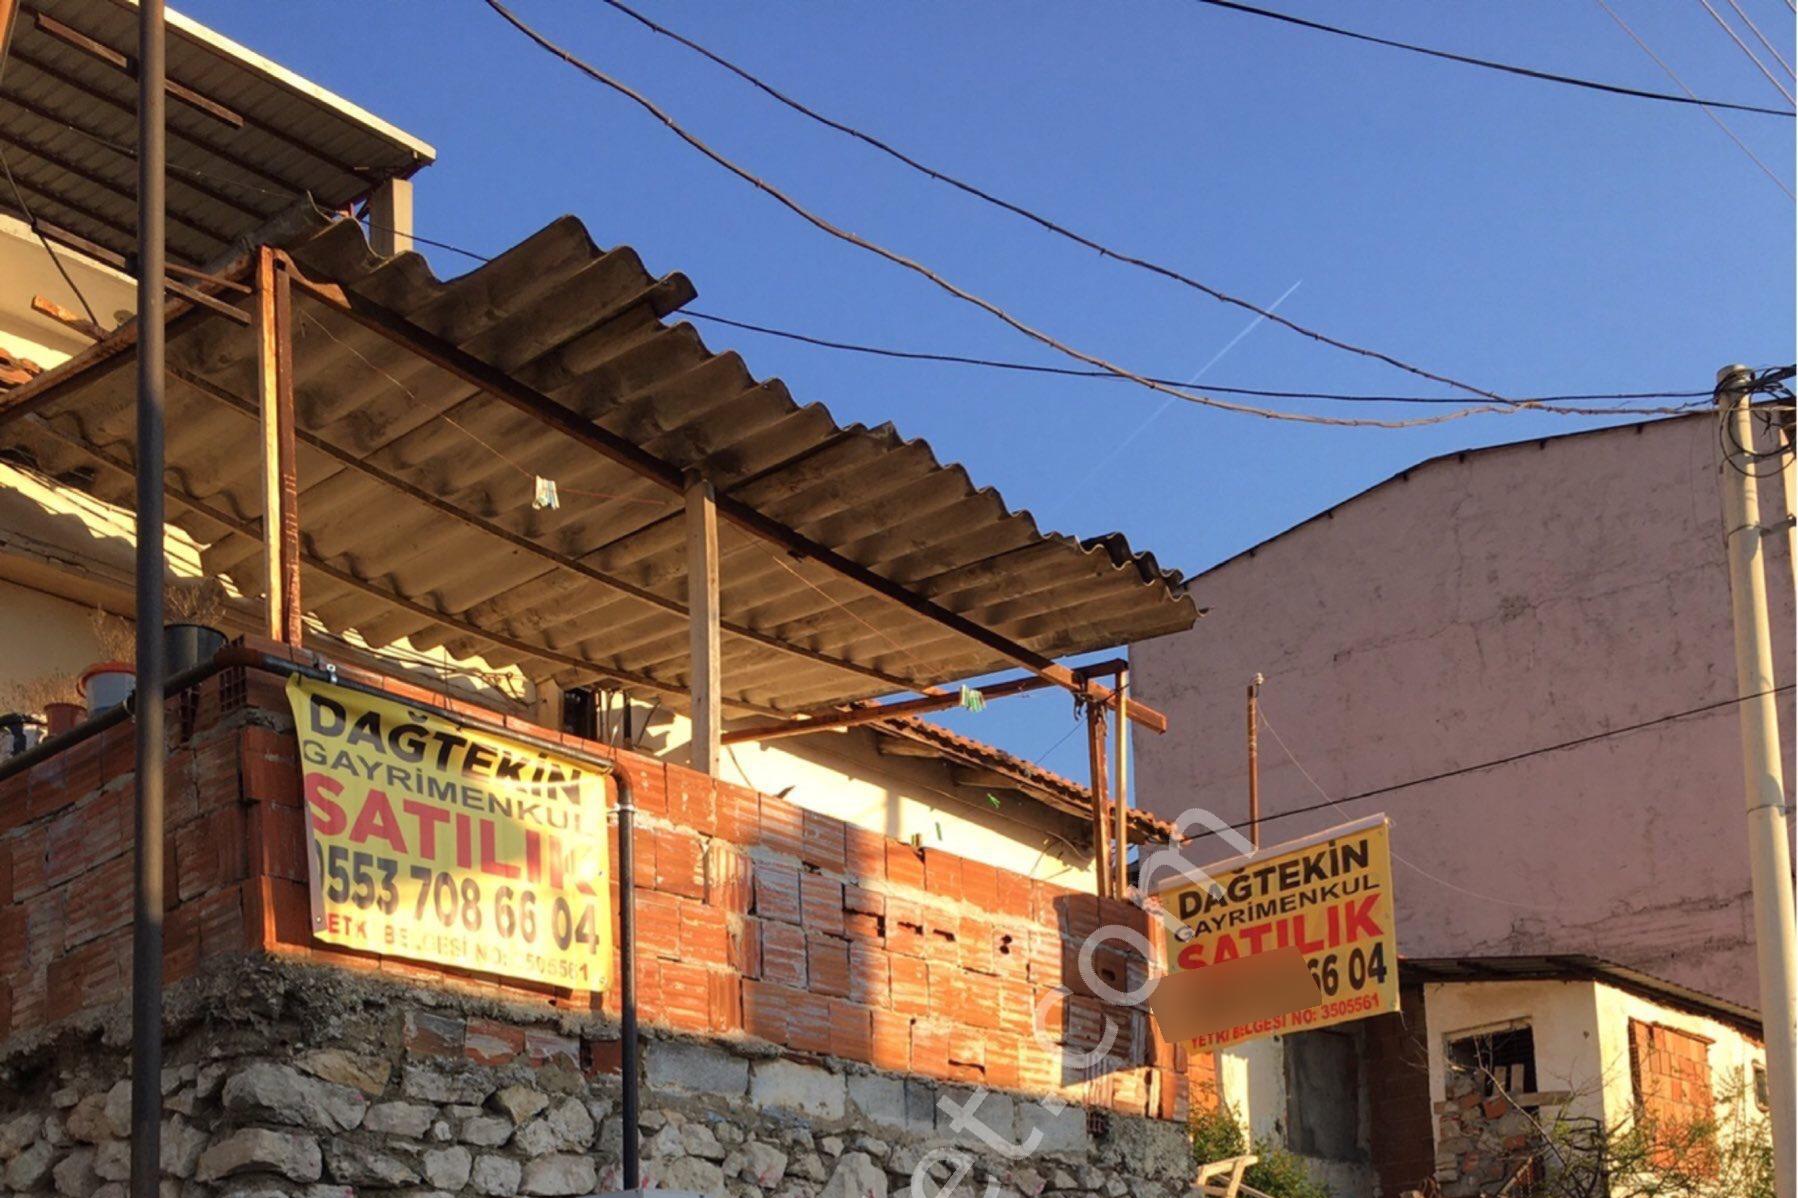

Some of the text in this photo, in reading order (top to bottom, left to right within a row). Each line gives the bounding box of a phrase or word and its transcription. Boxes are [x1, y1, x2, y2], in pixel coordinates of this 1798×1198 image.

[303, 739, 593, 837] GAYRİMENKUL
[310, 692, 582, 806] DAĞTEKİN
[304, 771, 598, 897] SATILIK
[410, 864, 482, 932] 708
[494, 885, 537, 944] 66
[552, 896, 600, 955] 04
[1174, 873, 1381, 943] GAYRİMENKUL
[1178, 838, 1369, 921] DAĞTEKİN
[1177, 893, 1385, 970] SATILIK
[1348, 941, 1387, 991] 04
[1321, 992, 1380, 1020] 3505561
